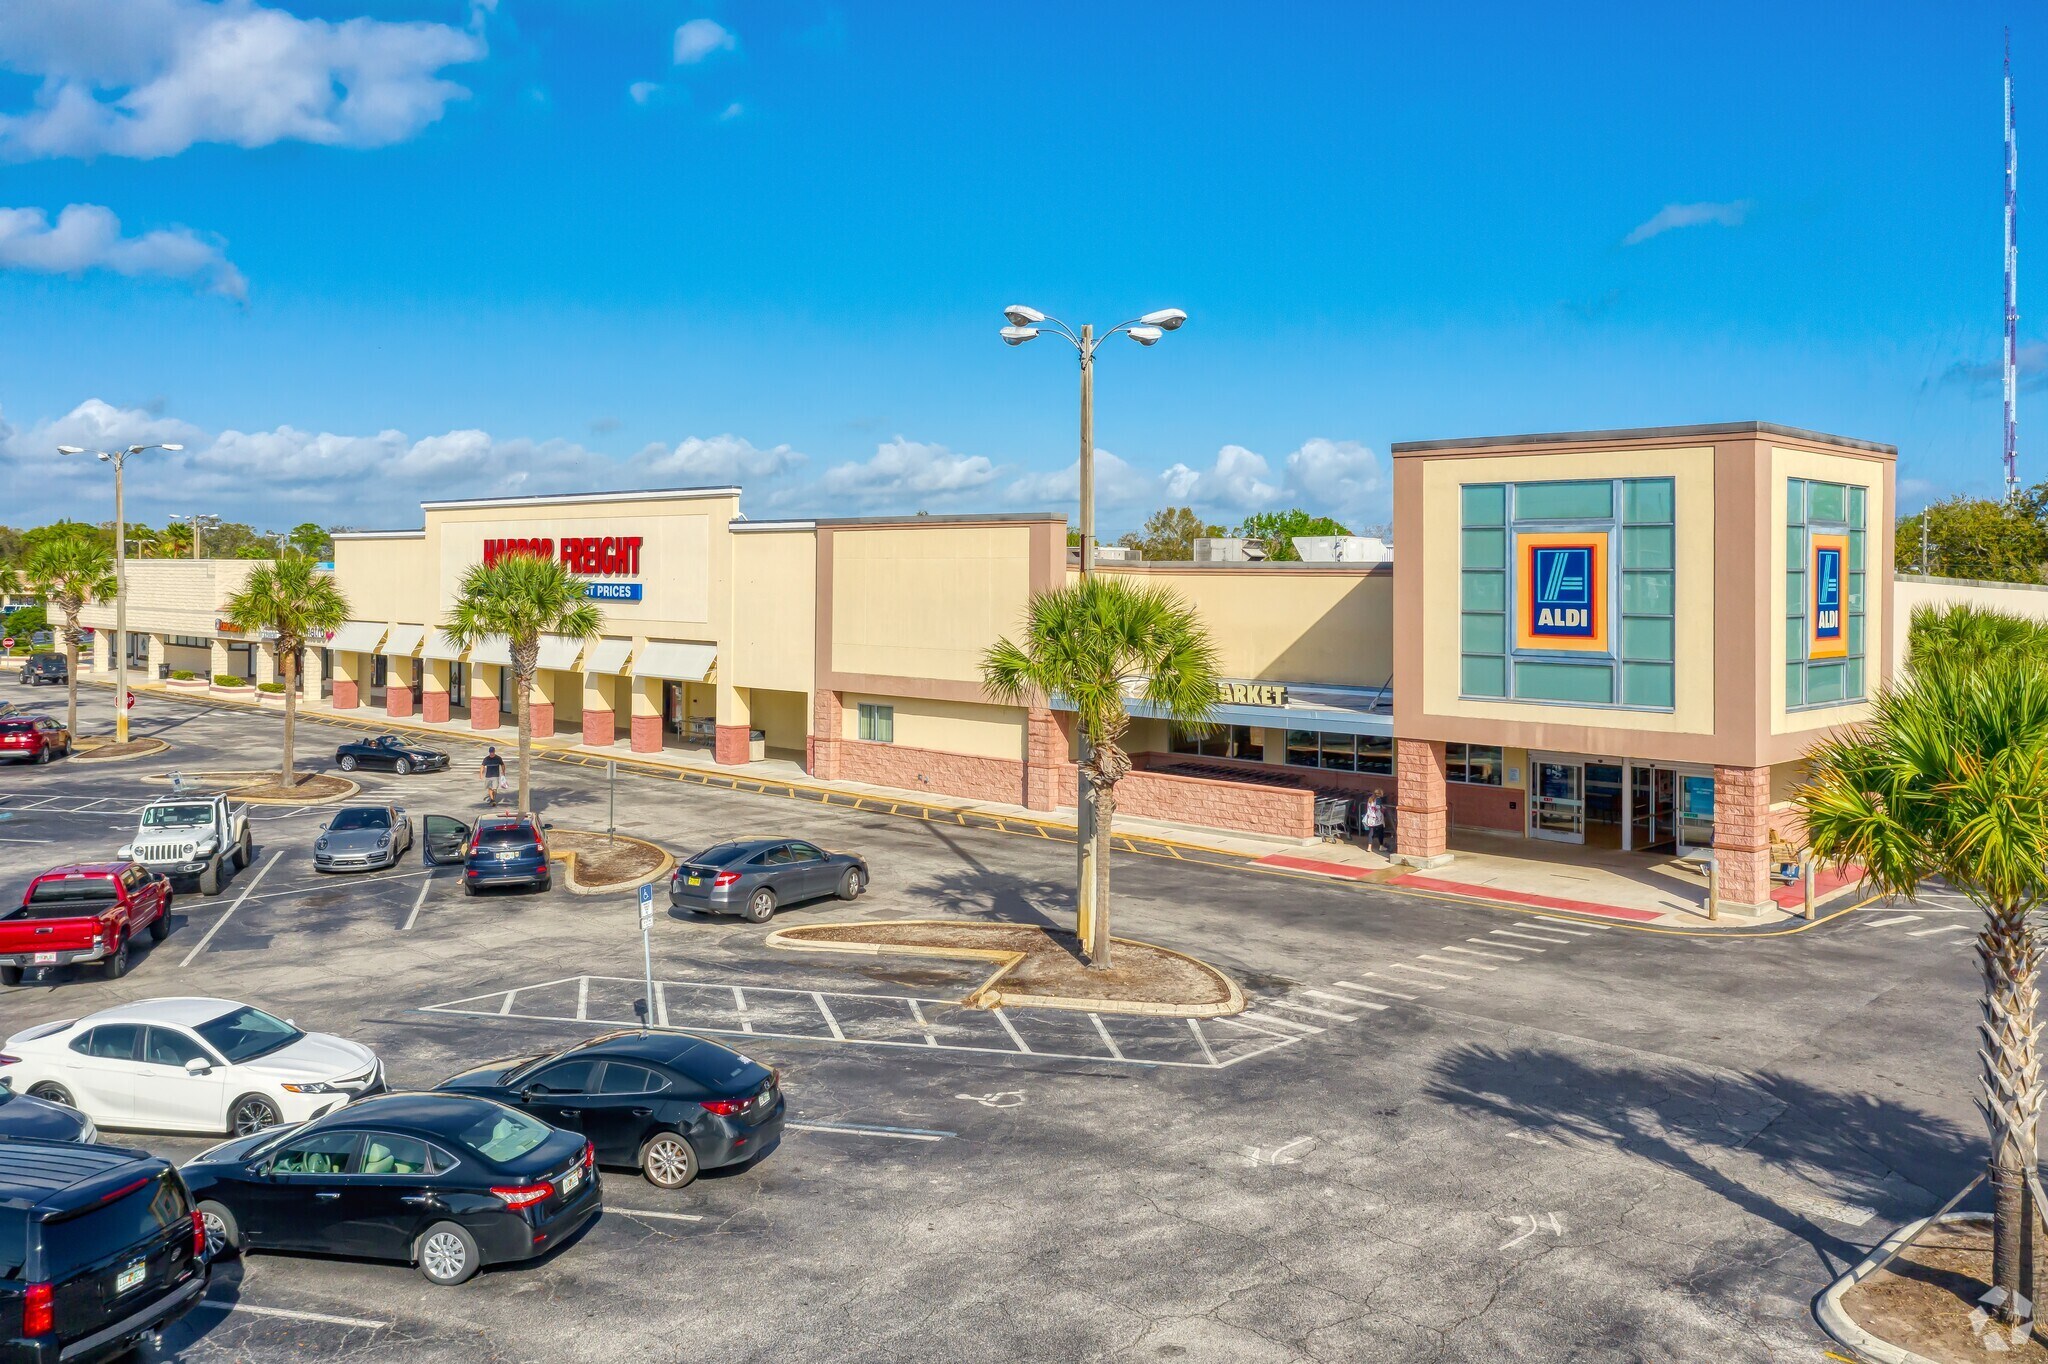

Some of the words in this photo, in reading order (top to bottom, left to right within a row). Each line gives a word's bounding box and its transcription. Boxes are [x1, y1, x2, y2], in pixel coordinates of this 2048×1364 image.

[560, 536, 643, 575] FREIGHT
[597, 585, 632, 598] PRICES
[1538, 608, 1588, 627] ALDI
[1818, 610, 1839, 629] ALDI
[1213, 681, 1287, 706] ARKET
